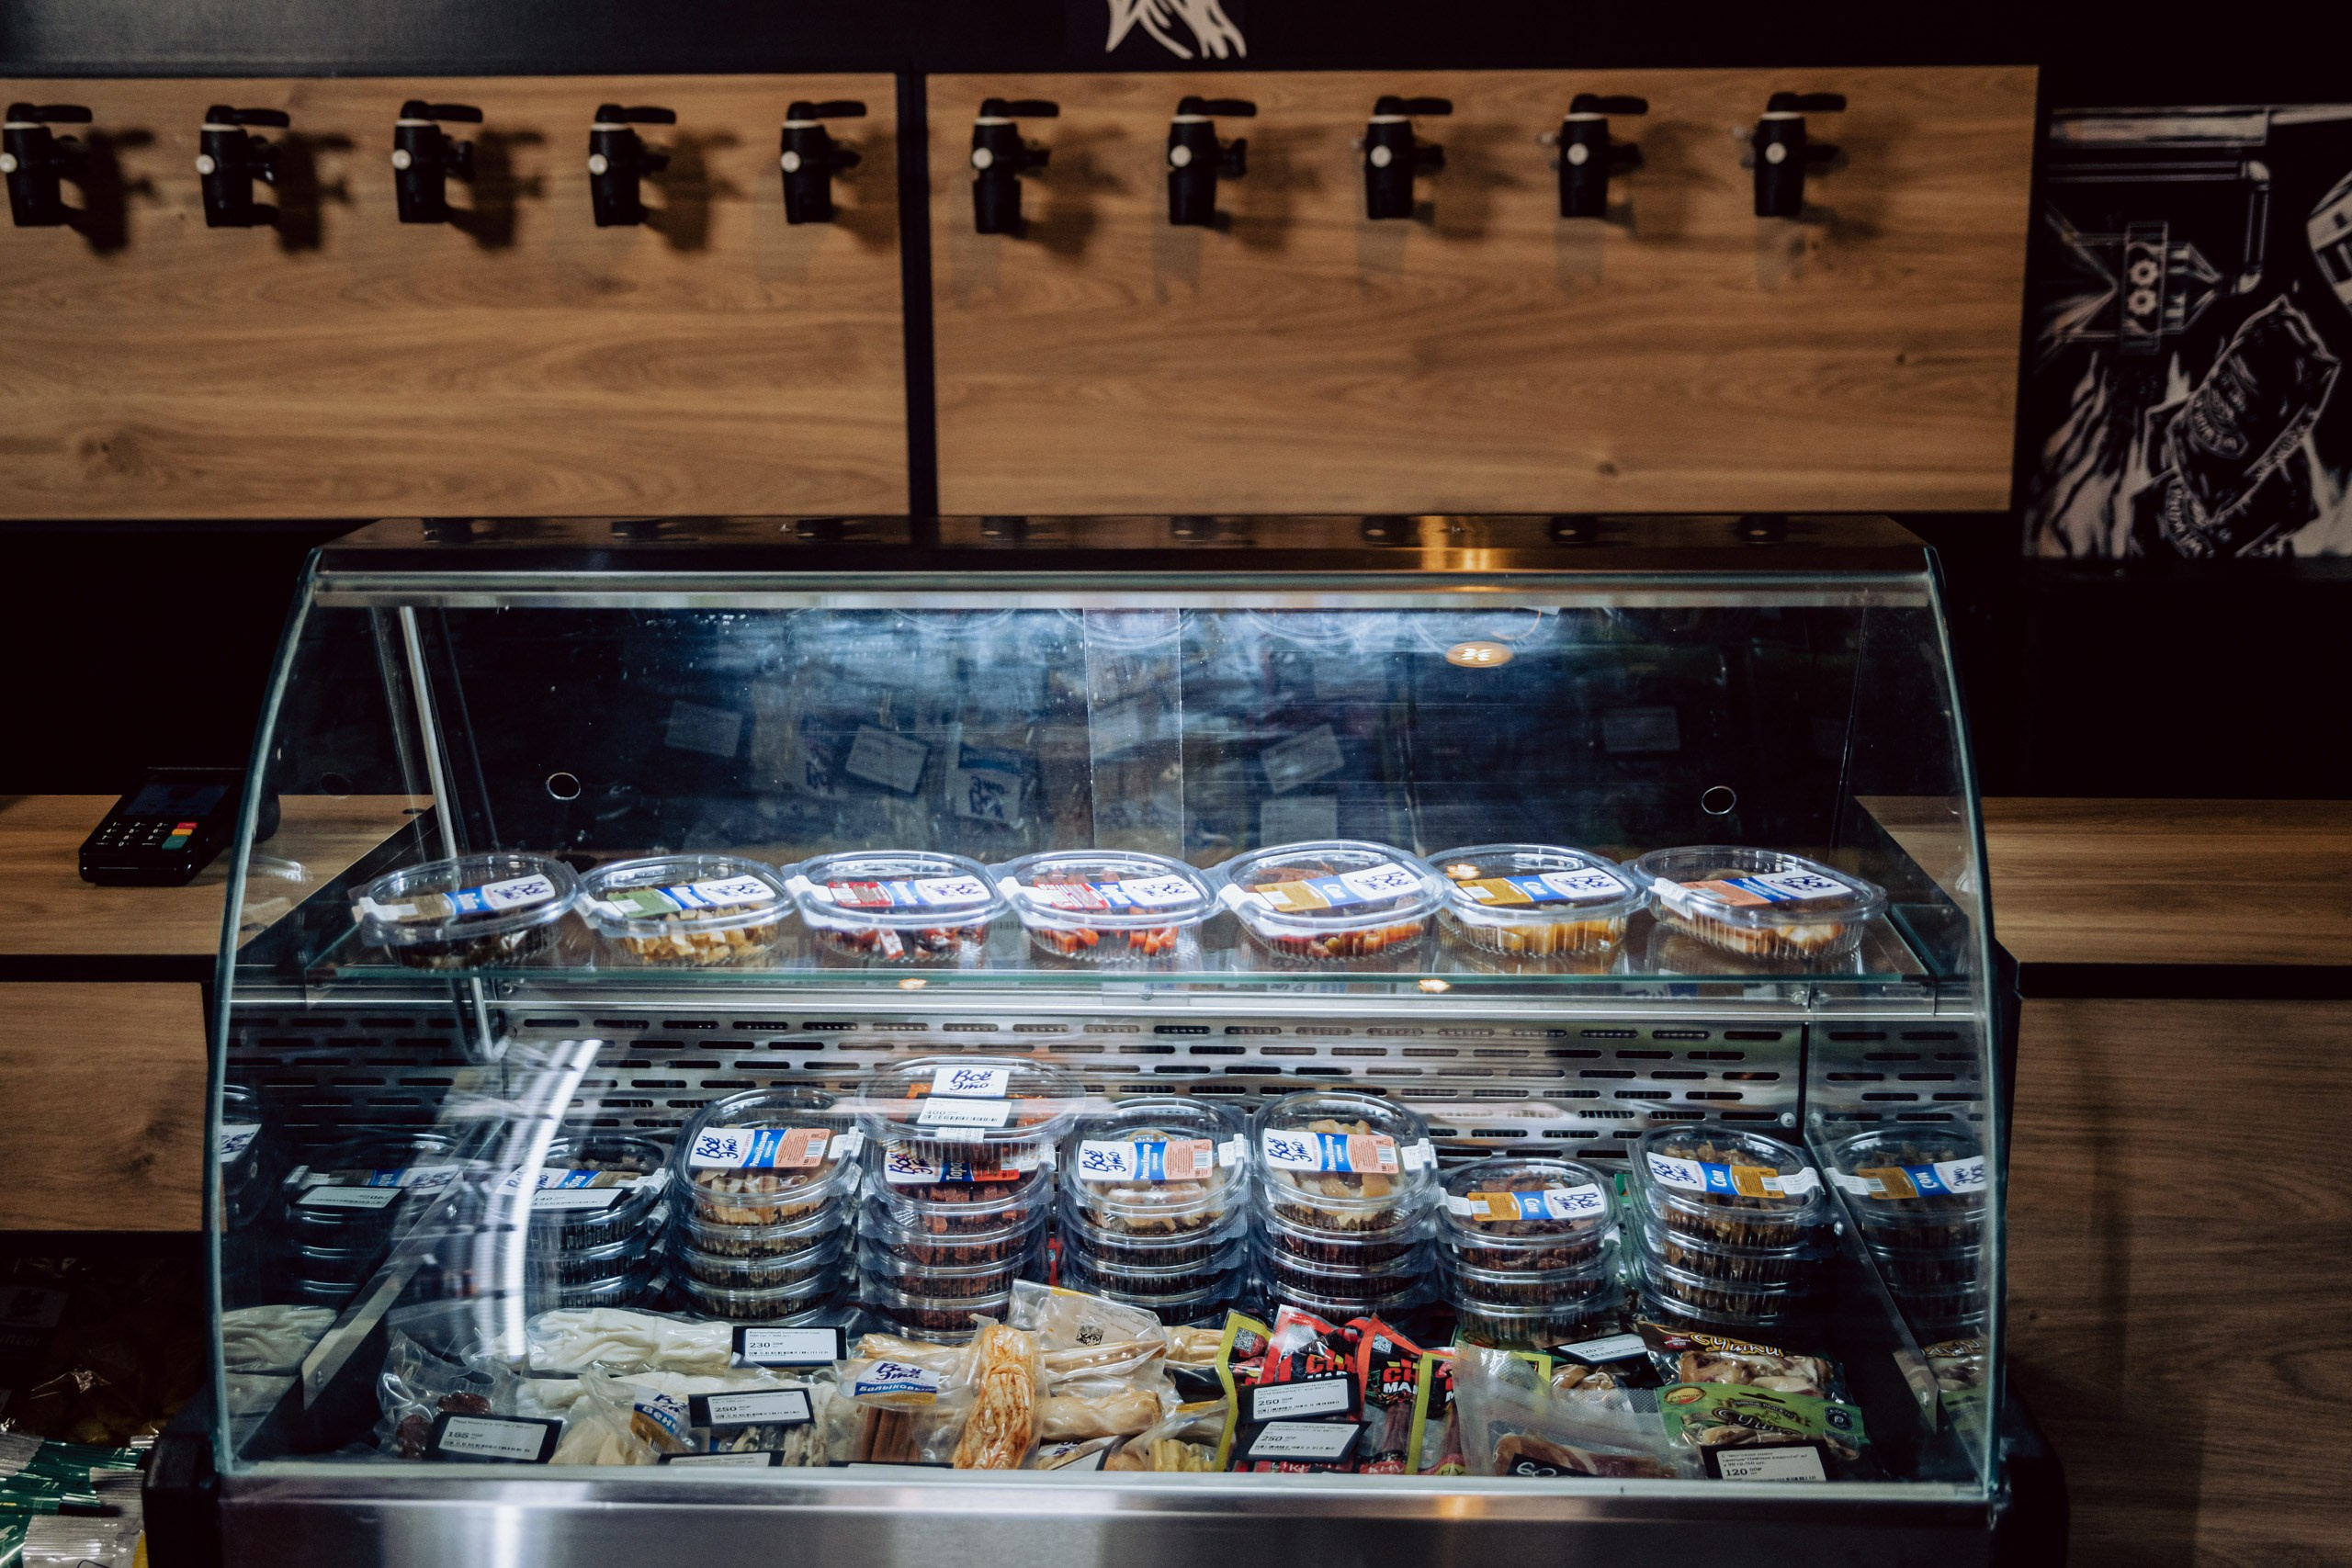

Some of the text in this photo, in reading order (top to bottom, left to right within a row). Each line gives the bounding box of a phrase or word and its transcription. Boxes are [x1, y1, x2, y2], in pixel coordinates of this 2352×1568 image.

[949, 1081, 989, 1091] Это
[950, 1069, 994, 1084] Всё
[695, 1135, 720, 1159] Всё
[718, 1138, 739, 1159] Это
[1267, 1137, 1294, 1161] Всё
[1291, 1140, 1312, 1162] Это
[1082, 1148, 1108, 1172] Всё
[1105, 1149, 1126, 1172] Это
[1650, 1158, 1676, 1181] Всё
[1711, 1170, 1728, 1187] Сом
[1523, 1198, 1540, 1213] Сом
[1570, 1191, 1600, 1209] Всё
[0, 1333, 40, 1348] ипсы
[1725, 1469, 1747, 1477] 120
